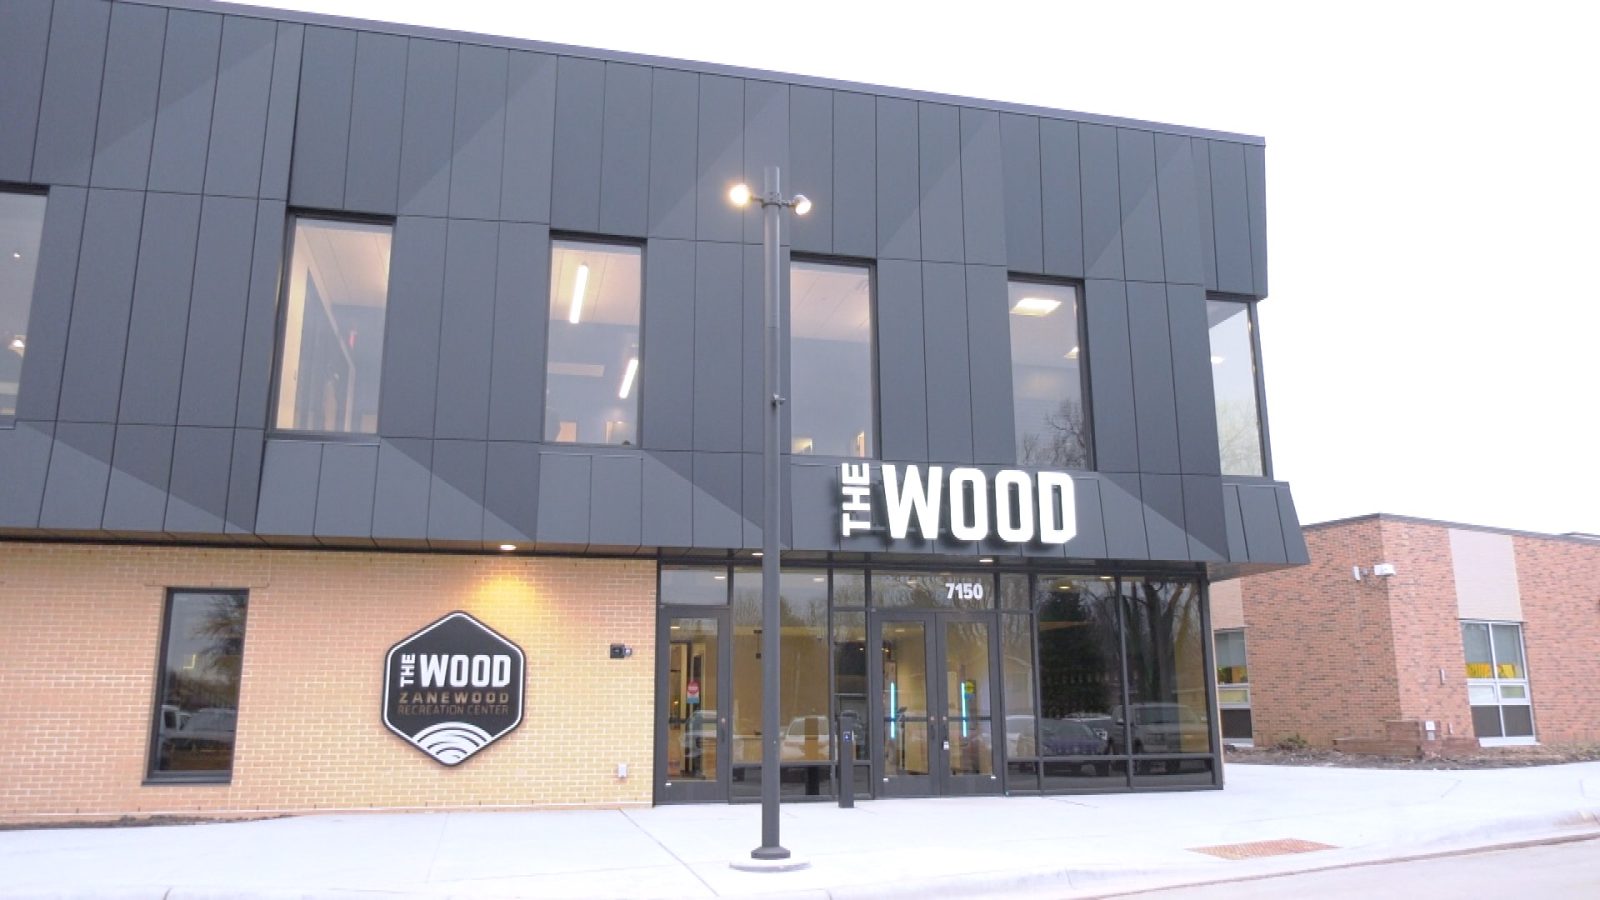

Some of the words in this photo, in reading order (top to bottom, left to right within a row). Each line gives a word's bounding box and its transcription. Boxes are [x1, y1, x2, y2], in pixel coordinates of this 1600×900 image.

[842, 463, 871, 537] THE
[881, 464, 1077, 544] WOOD
[945, 583, 984, 600] 7150
[400, 653, 416, 688] THE
[420, 654, 511, 688] WOOD
[399, 691, 509, 703] ZANEWOOD
[399, 704, 464, 715] RECREATION
[467, 704, 509, 715] CENTER
